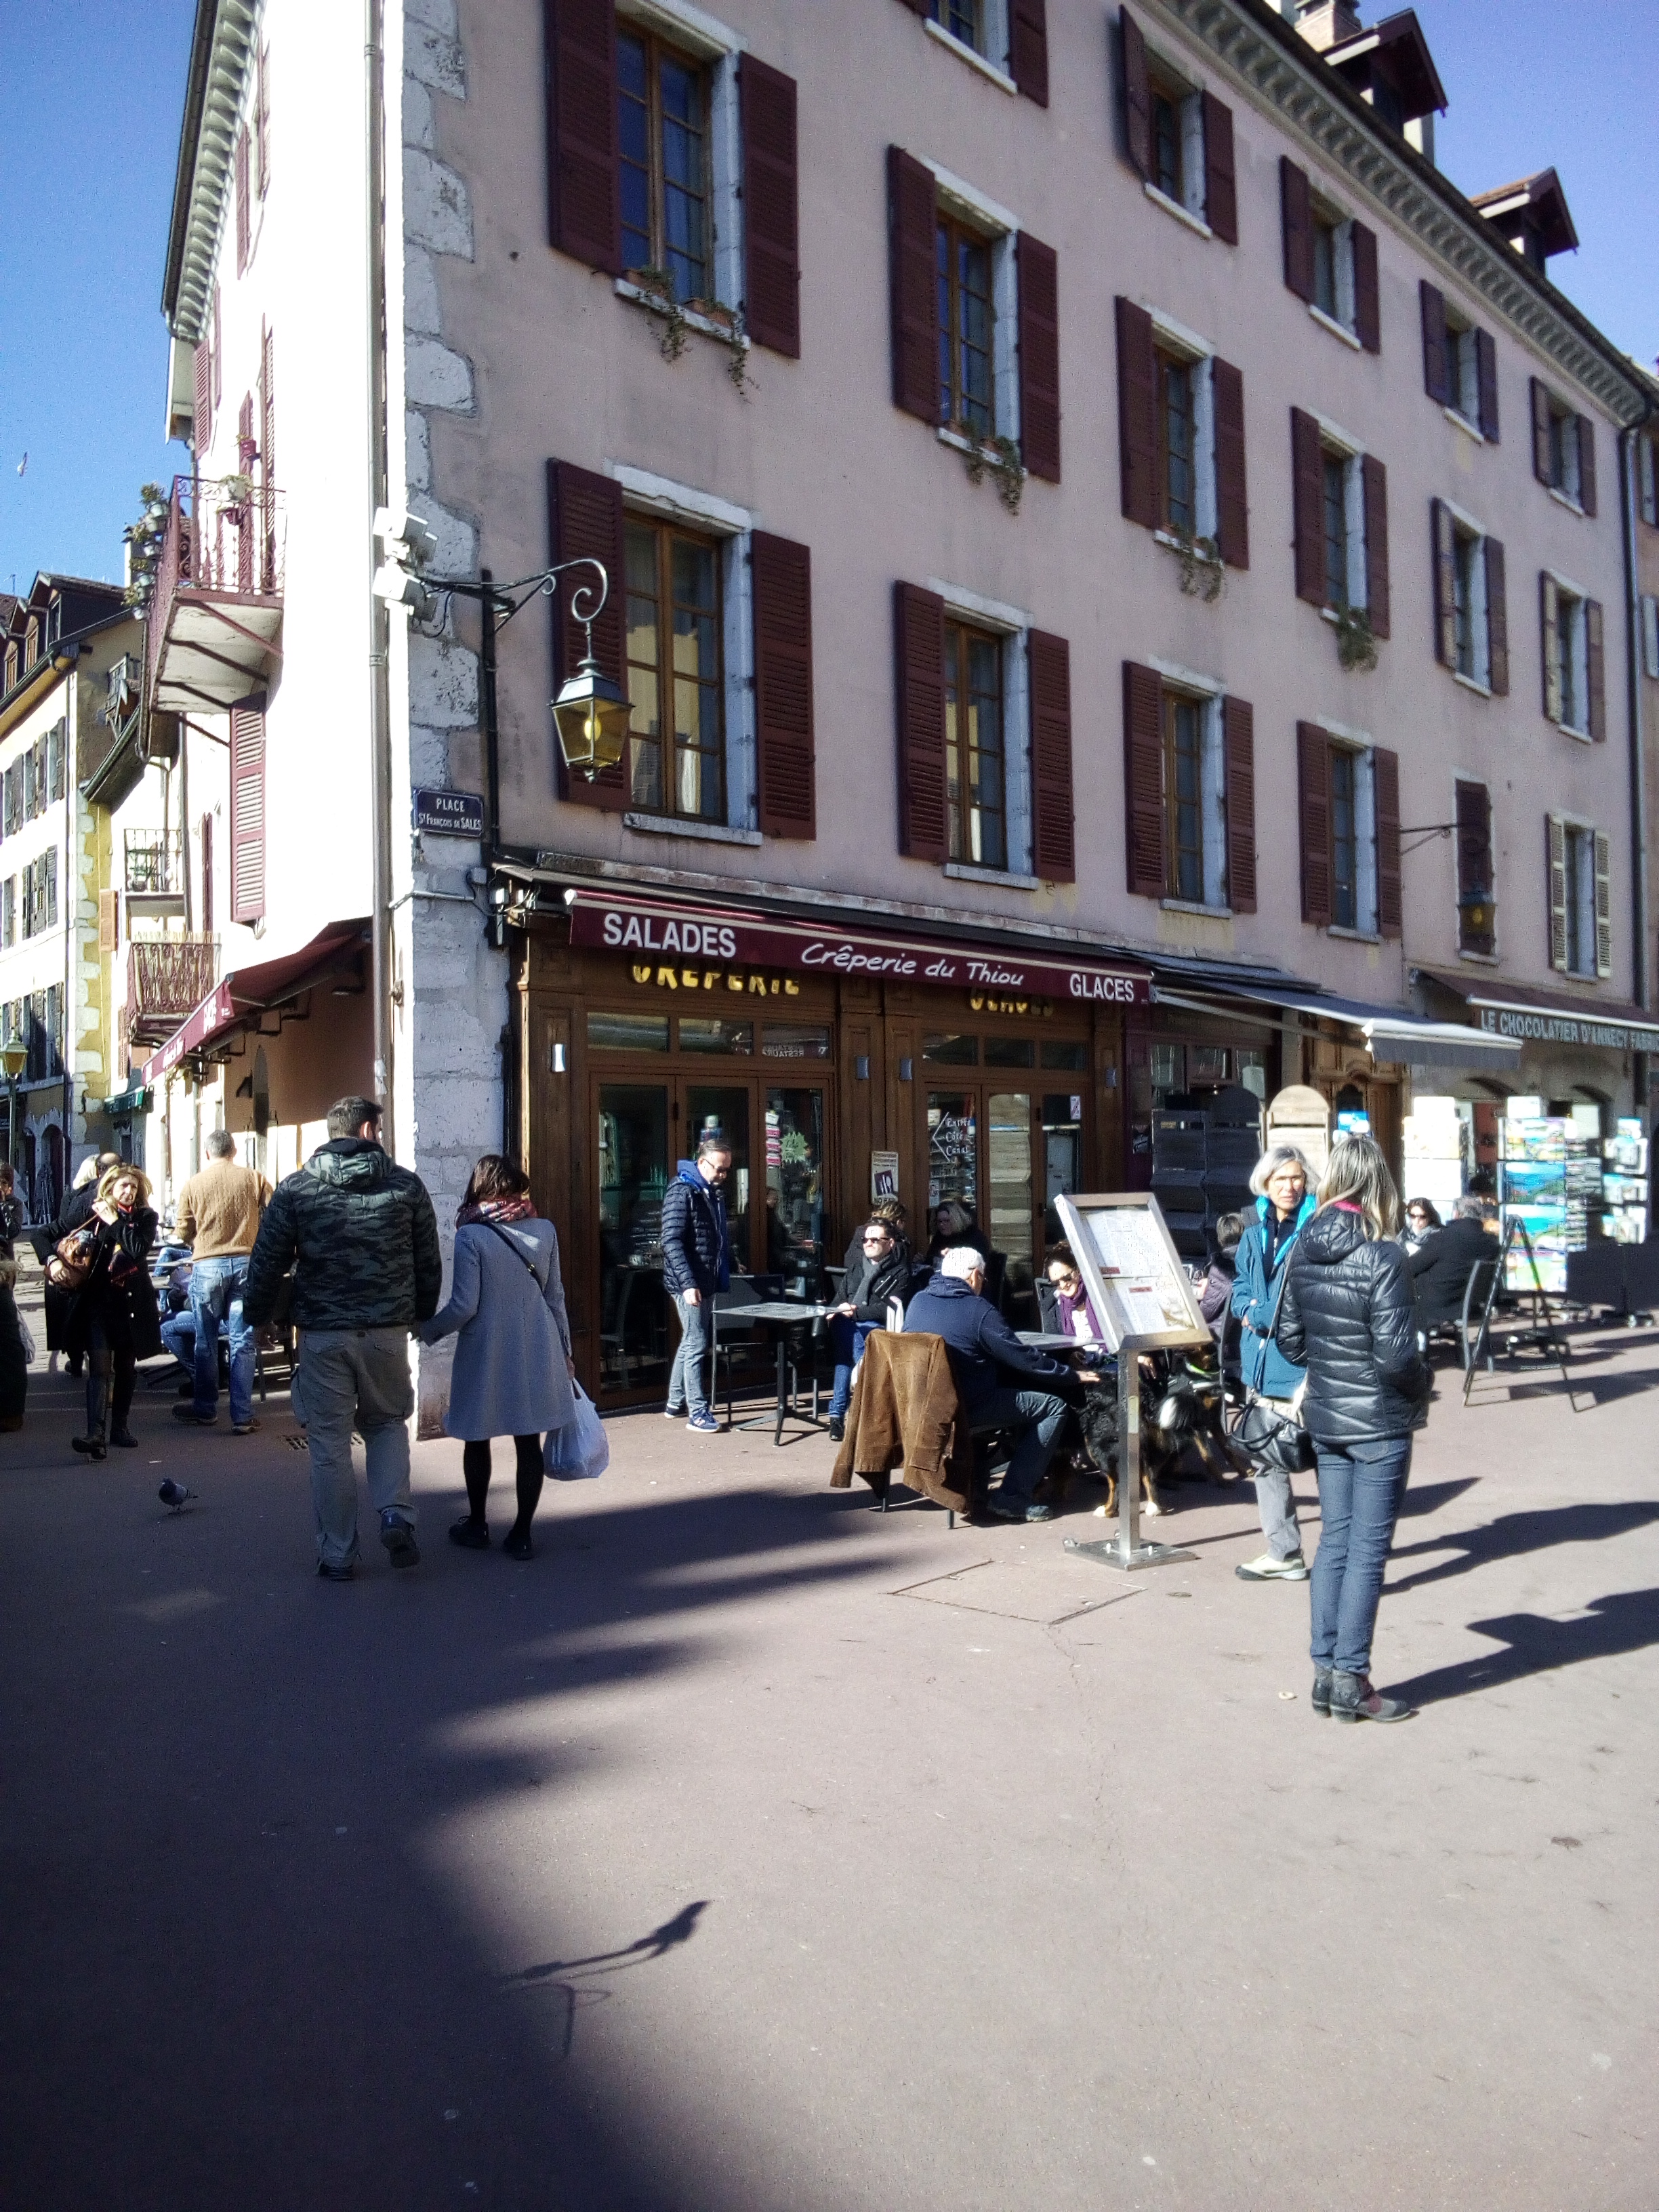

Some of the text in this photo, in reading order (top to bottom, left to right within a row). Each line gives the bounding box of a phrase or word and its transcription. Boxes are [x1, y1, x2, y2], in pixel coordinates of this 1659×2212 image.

[436, 798, 465, 812] PLACE
[461, 817, 482, 831] SALES
[602, 912, 737, 958] SALADES
[800, 943, 1025, 986] Crêperie du Thiou
[1069, 972, 1135, 1004] GLACES
[1481, 1008, 1496, 1033] LE
[1500, 1012, 1578, 1042] CHOCOLATIER
